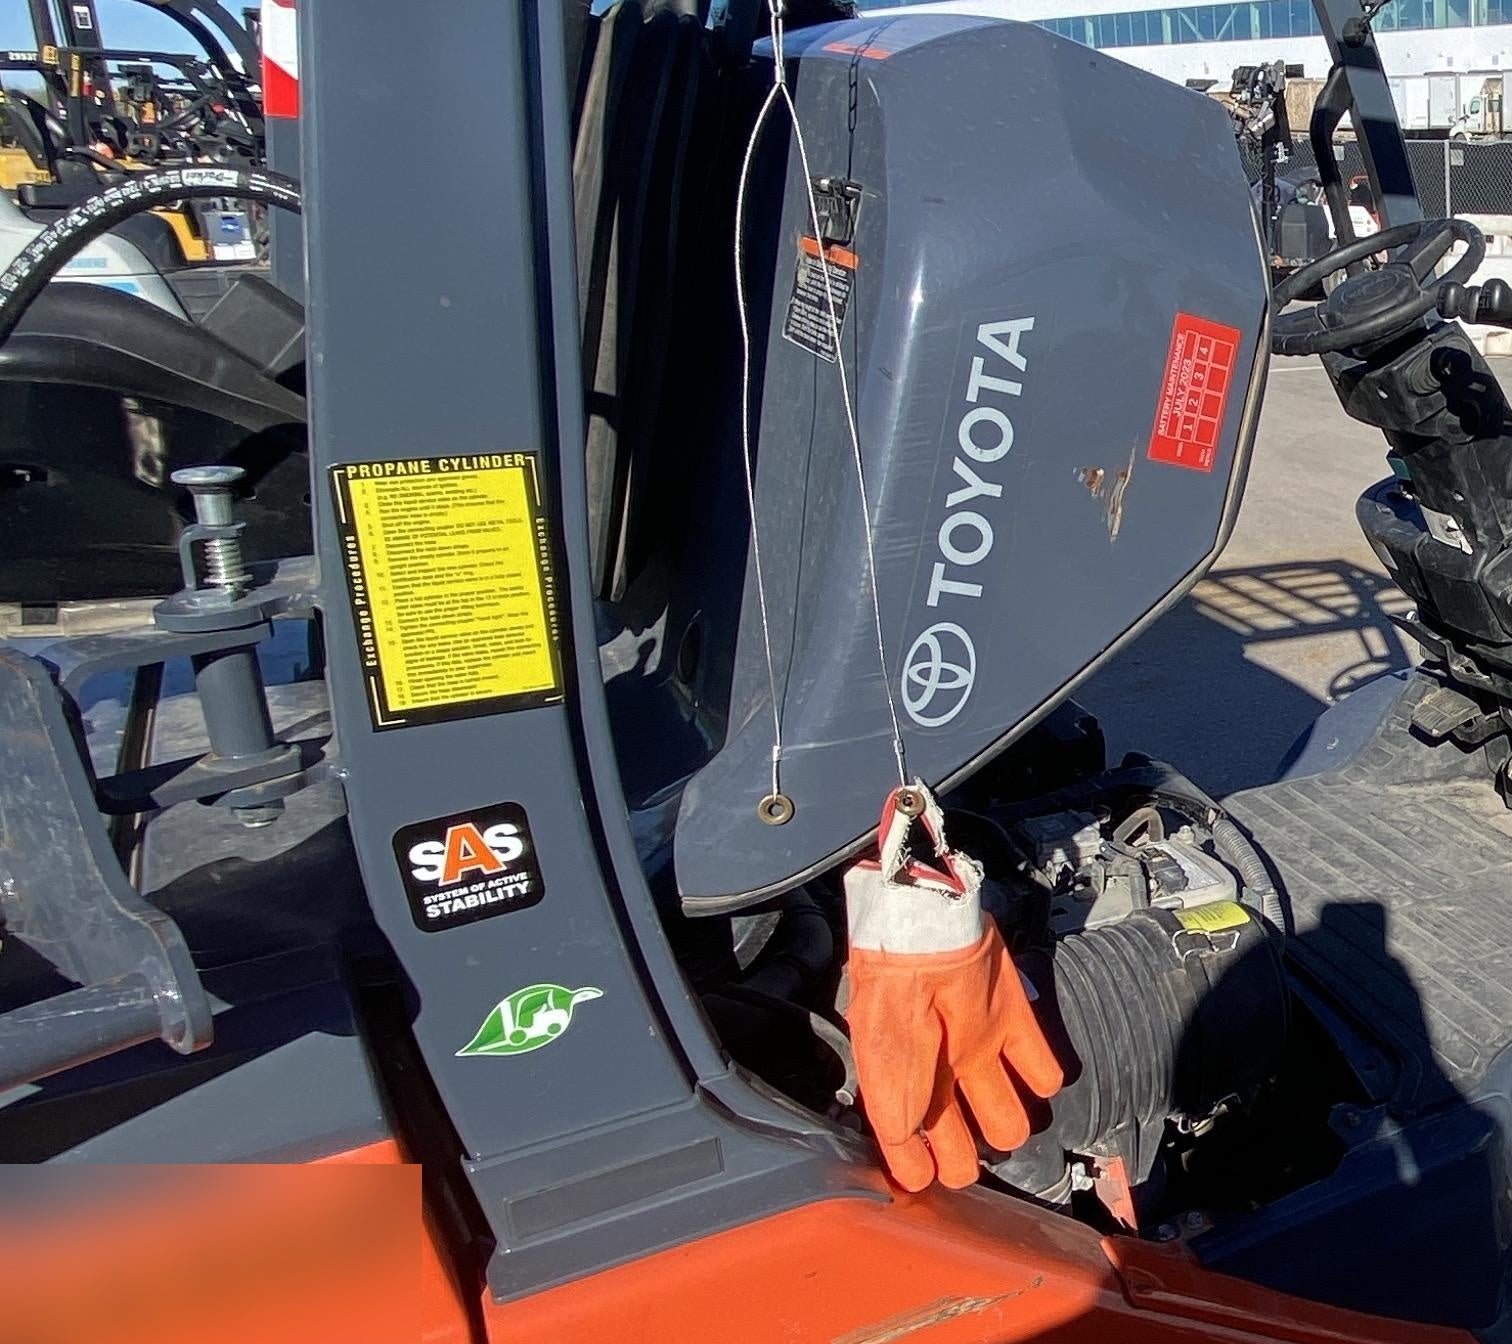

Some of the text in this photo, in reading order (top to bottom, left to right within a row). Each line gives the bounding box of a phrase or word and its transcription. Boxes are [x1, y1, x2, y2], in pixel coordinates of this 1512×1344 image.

[1157, 332, 1185, 436] BATTERY MAINTENANCE
[1173, 358, 1192, 417] JULY 2023
[1183, 346, 1209, 431] 1 2 3 4
[346, 453, 527, 480] PROPANE CYLINDER
[926, 315, 1036, 609] TOYOTA
[344, 535, 379, 668] Exchange Procedures
[408, 820, 525, 888] SAS
[422, 870, 529, 905] SYSTEM OF ACTIVE
[426, 879, 531, 919] STABILITY
